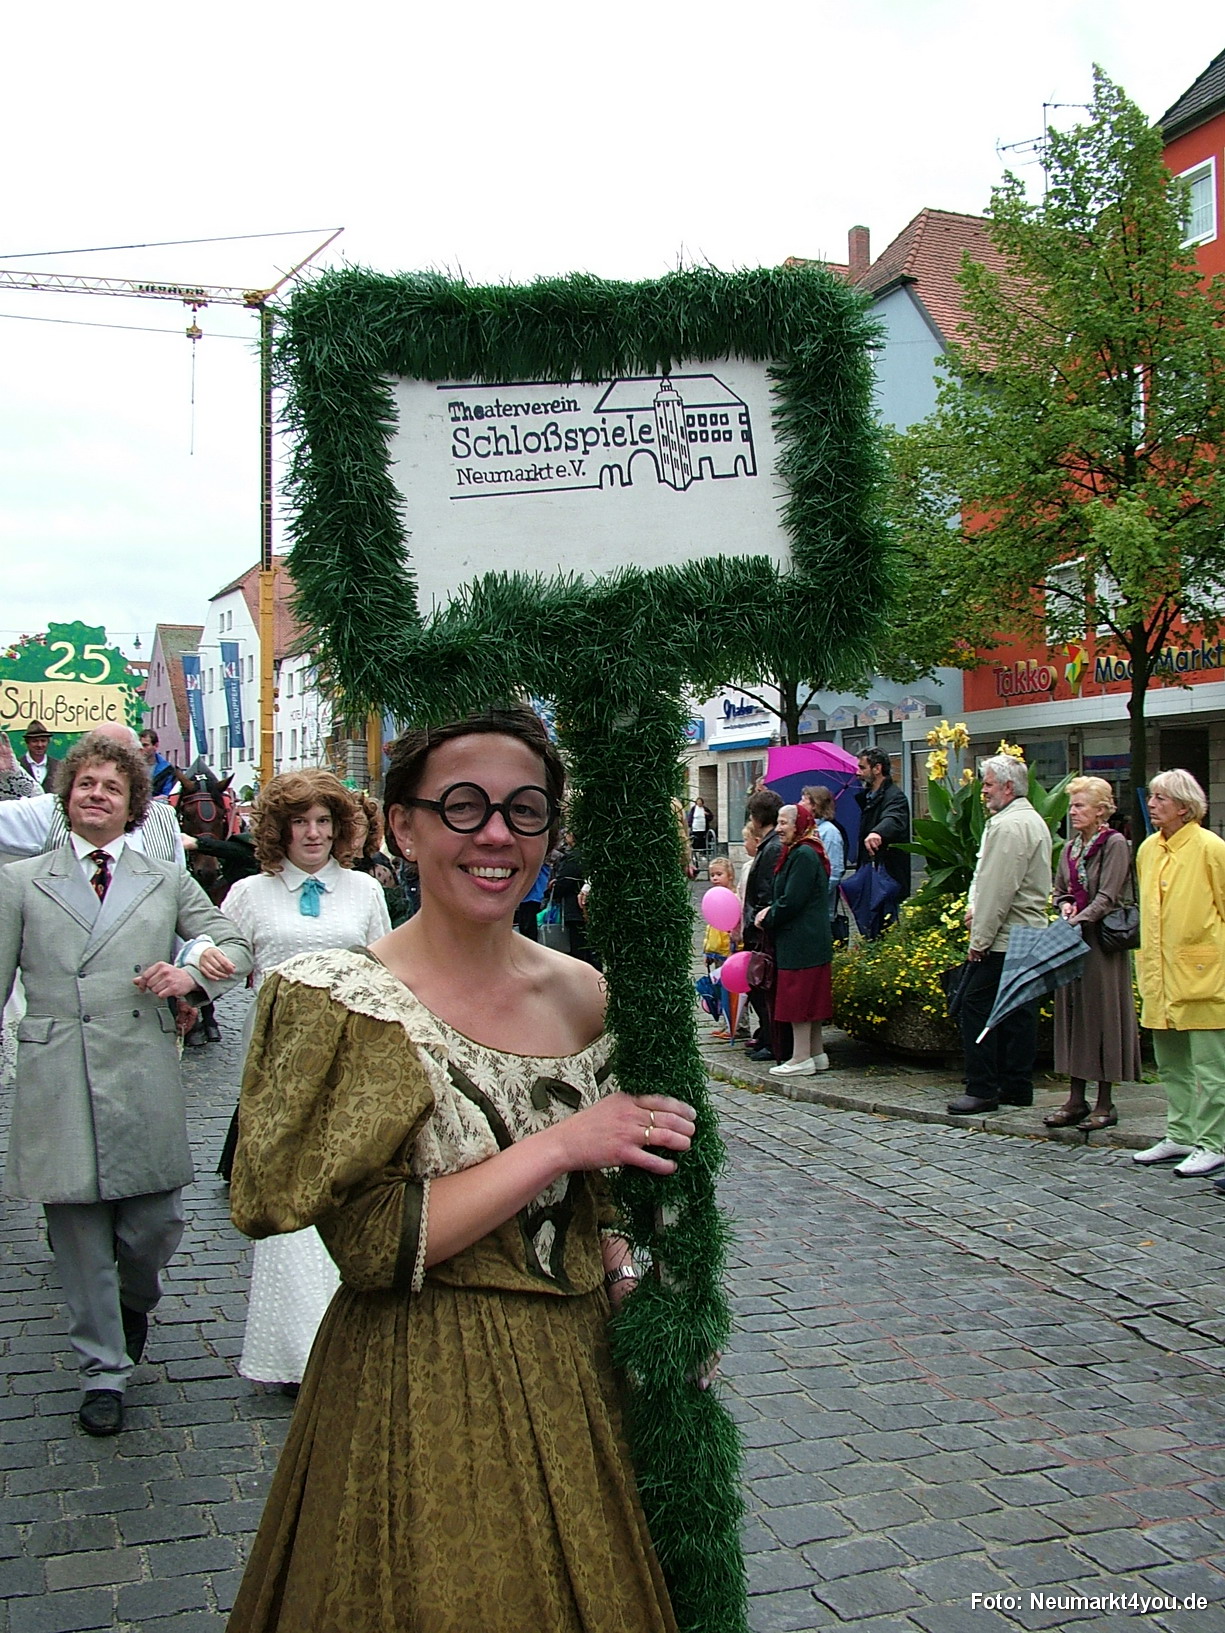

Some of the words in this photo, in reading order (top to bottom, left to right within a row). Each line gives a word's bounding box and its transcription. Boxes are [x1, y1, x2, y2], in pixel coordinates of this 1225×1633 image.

[448, 396, 581, 422] Theaterverein
[451, 414, 656, 459] Schloßspiele
[456, 462, 555, 485] Neumarkt
[44, 641, 111, 684] 25
[992, 659, 1051, 696] Takko
